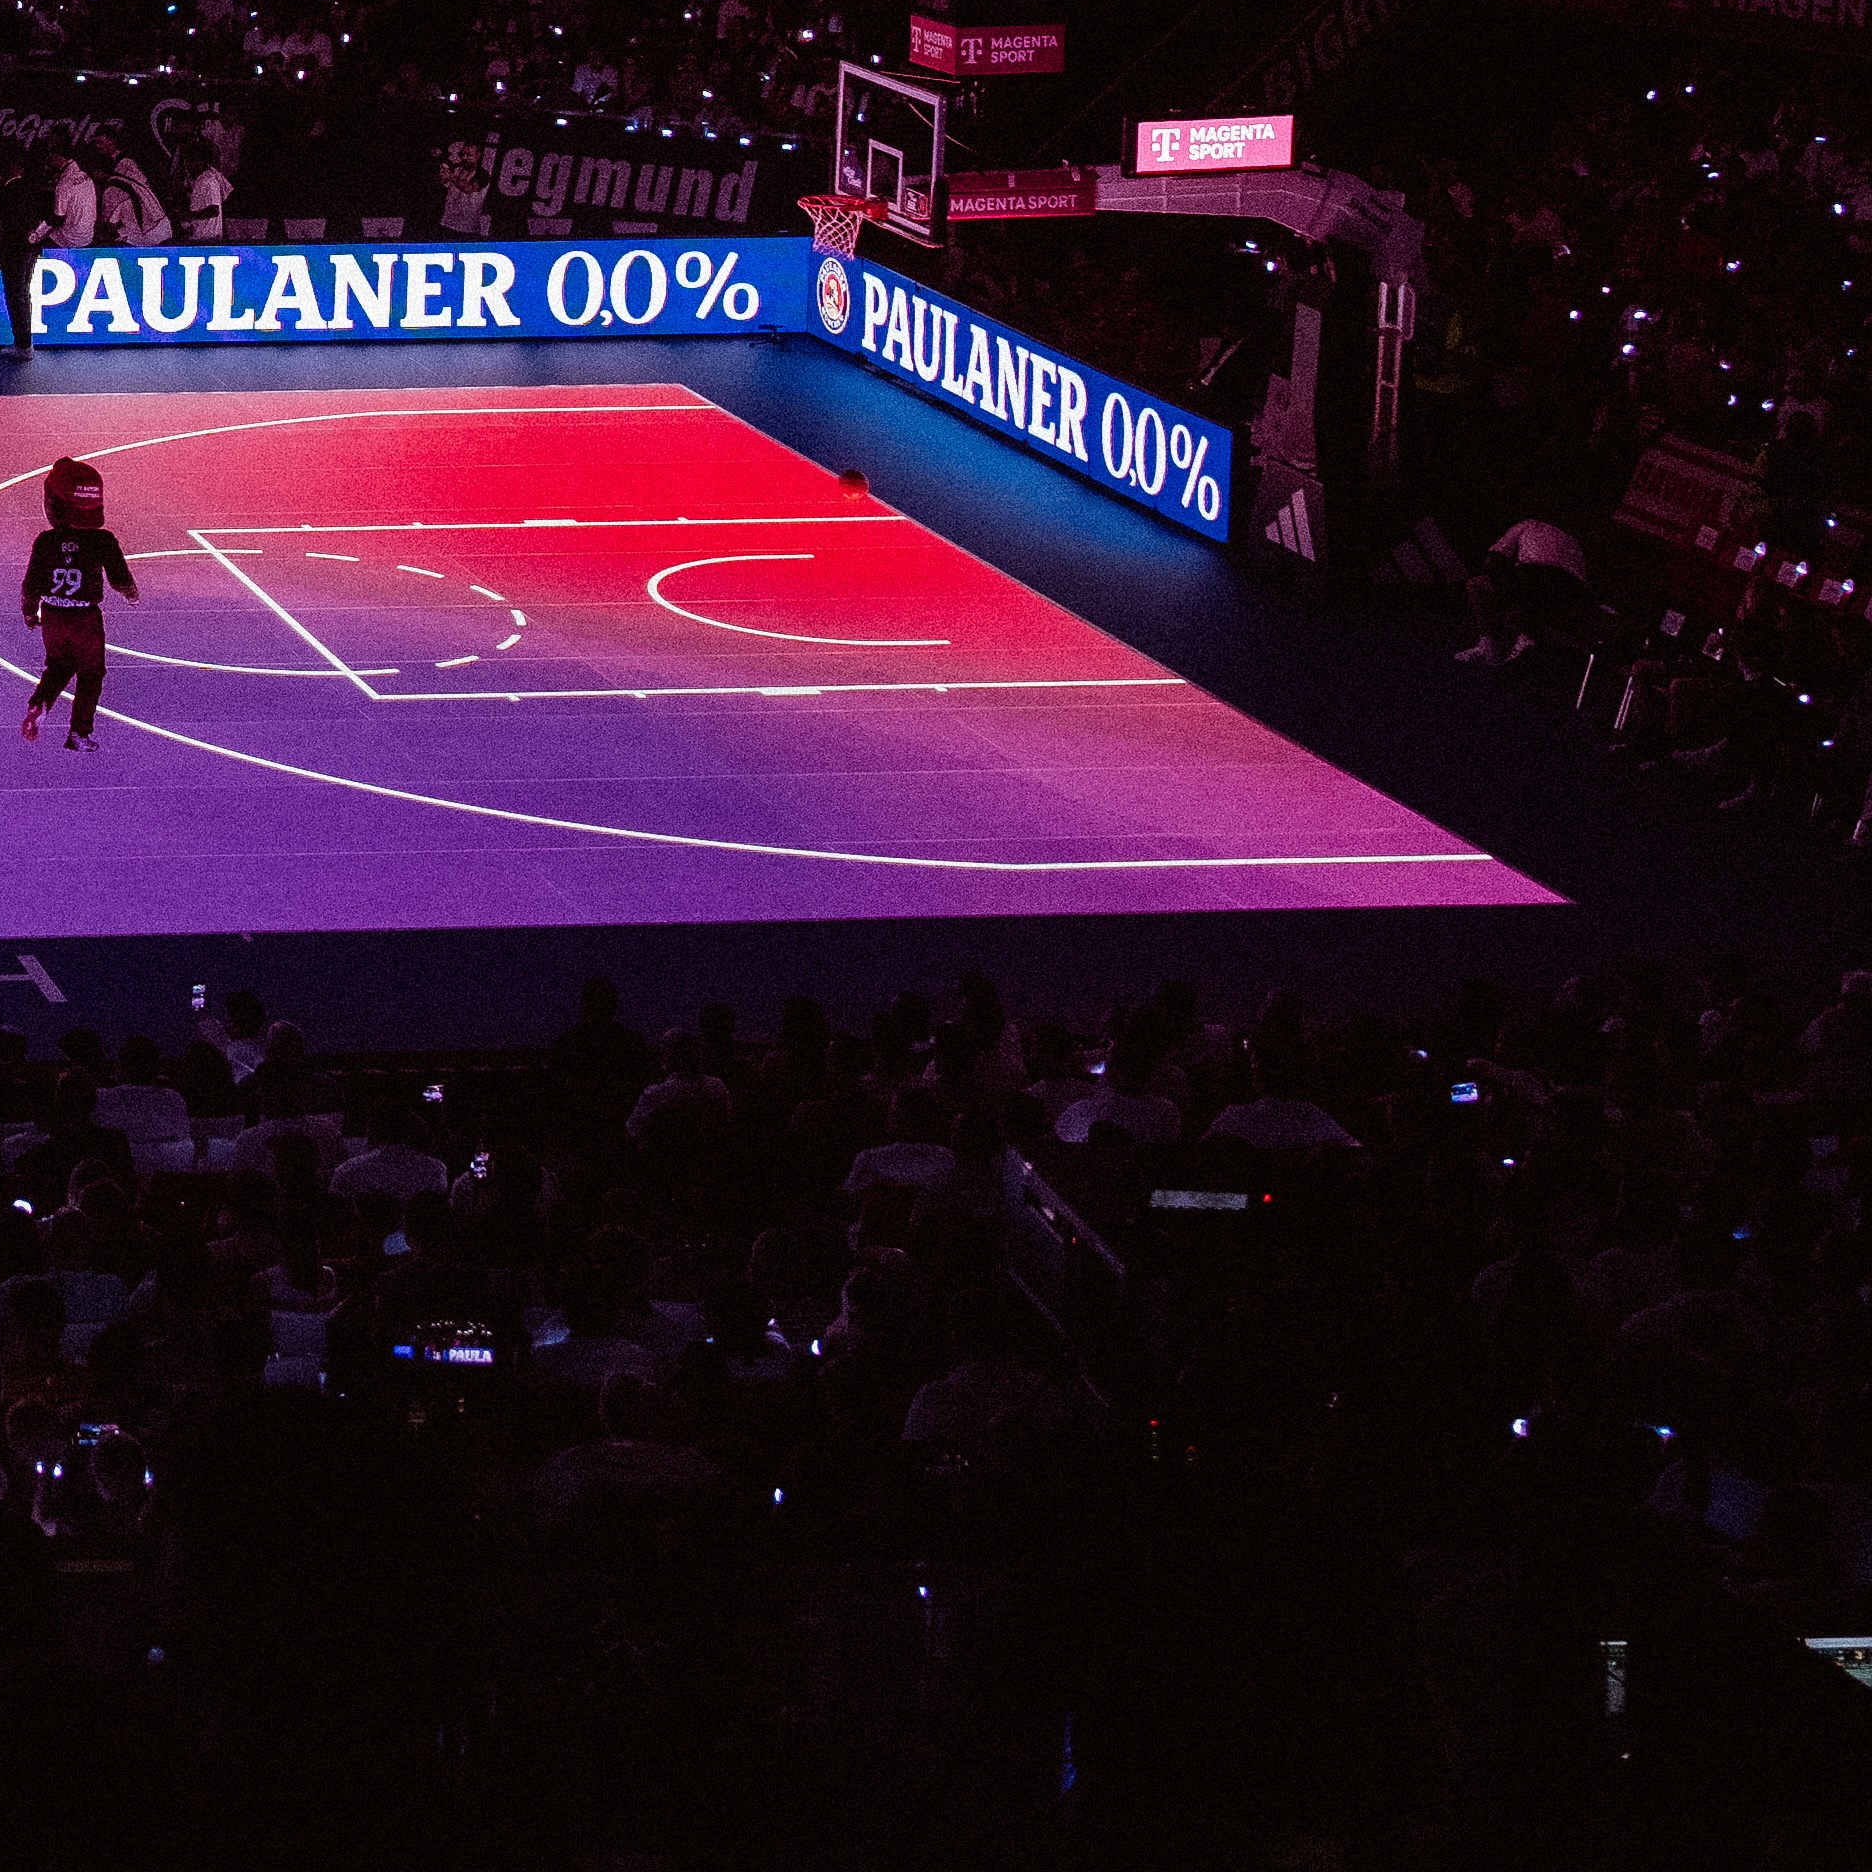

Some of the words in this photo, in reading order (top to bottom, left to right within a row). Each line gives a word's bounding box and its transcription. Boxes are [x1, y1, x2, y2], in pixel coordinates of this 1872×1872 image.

[990, 35, 1059, 49] MAGENTA
[990, 50, 1035, 63] SPORT
[1189, 123, 1276, 144] MAGENTA
[1188, 142, 1247, 161] SPORT
[30, 252, 521, 335] PAULANER
[546, 249, 760, 327] 0,0%
[861, 271, 1089, 463] PAULANER
[1101, 392, 1221, 521] 0,0%
[50, 567, 83, 596] 99
